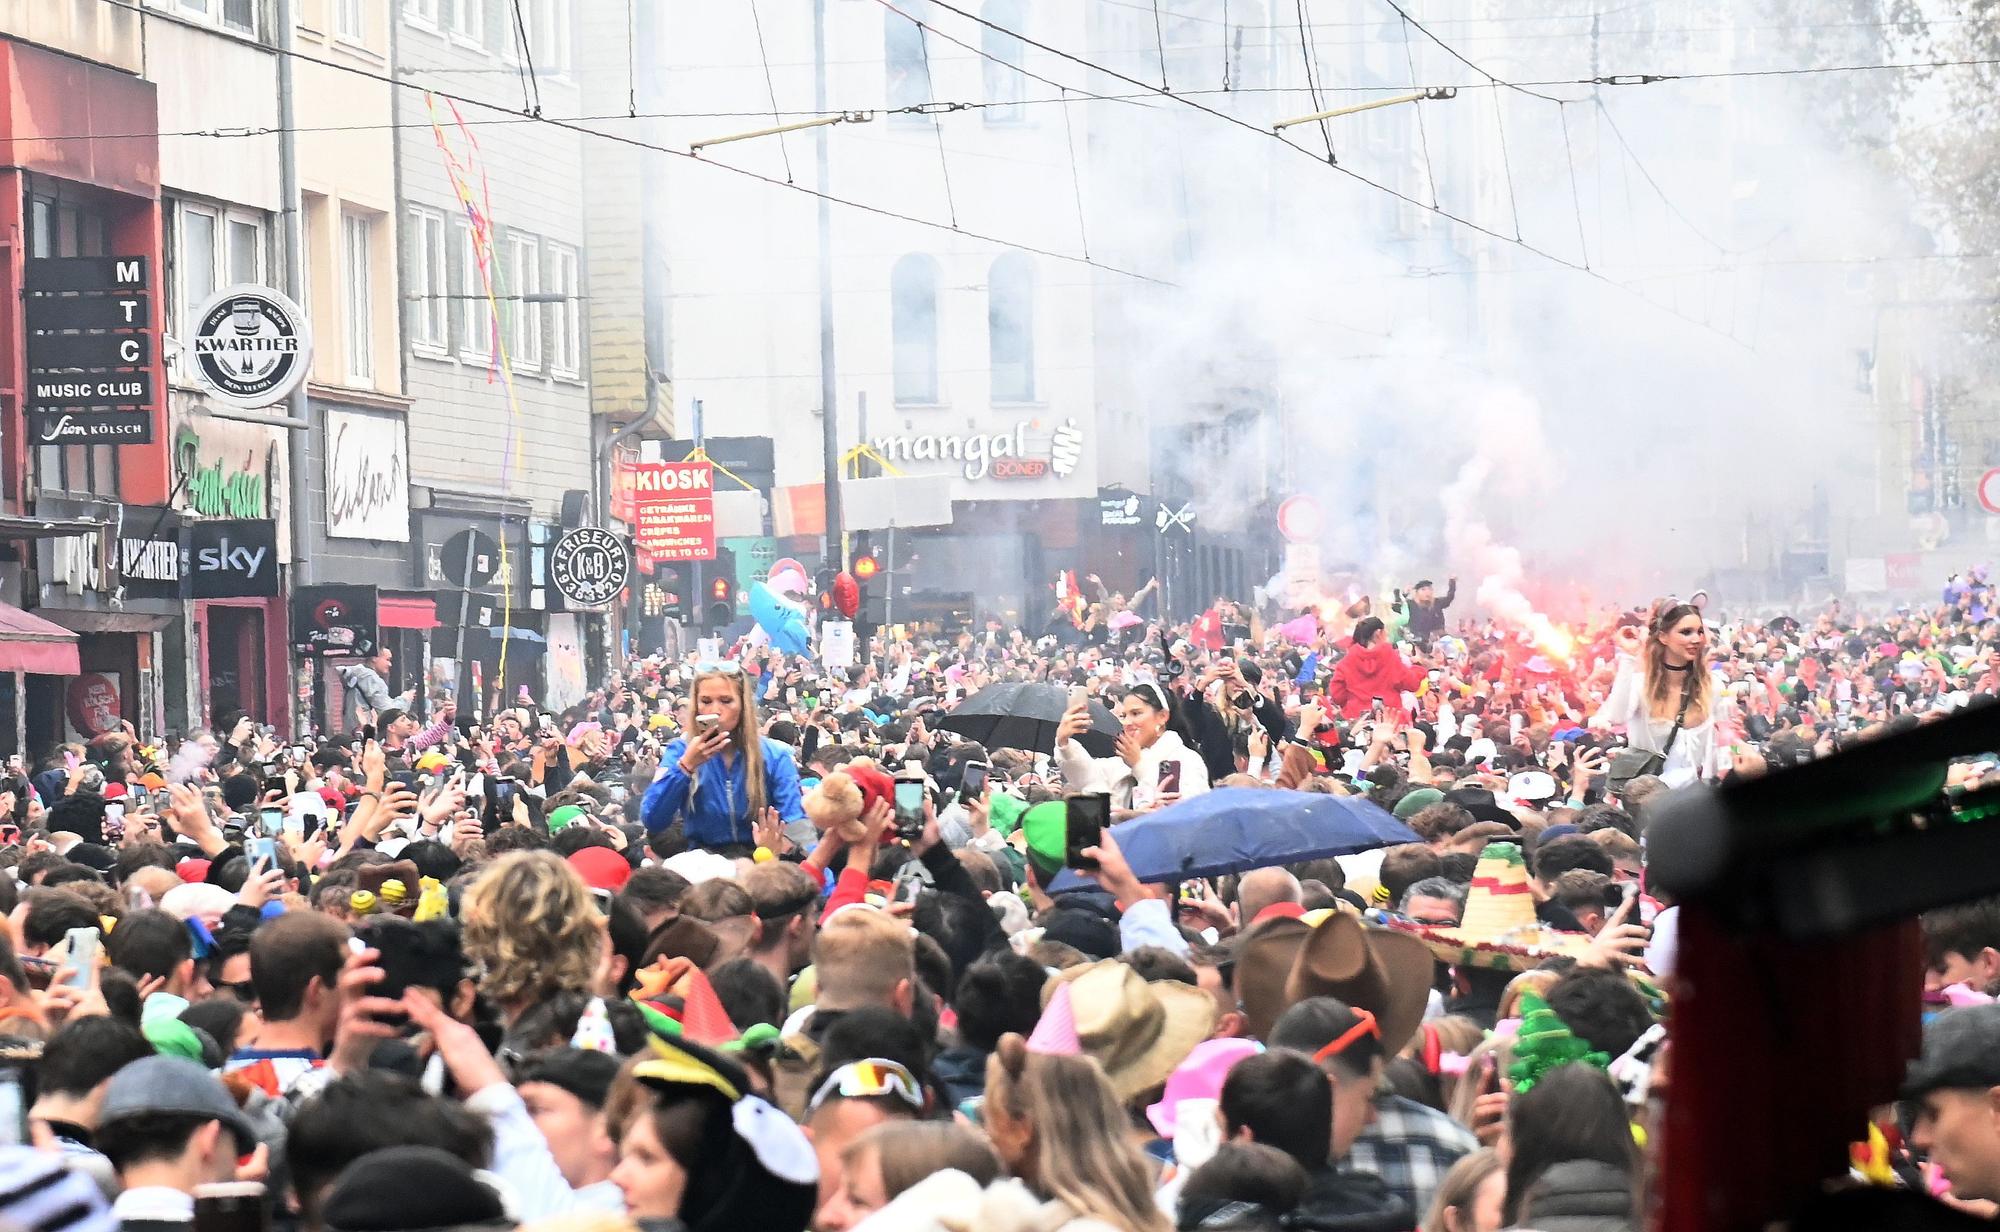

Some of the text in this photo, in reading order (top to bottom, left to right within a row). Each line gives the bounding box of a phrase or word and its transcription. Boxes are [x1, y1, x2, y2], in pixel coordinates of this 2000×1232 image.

[116, 261, 140, 283] M
[119, 300, 138, 323] T
[120, 340, 140, 362] C
[195, 338, 299, 352] KWARTIER
[37, 382, 143, 398] MUSIC CLUB
[90, 423, 142, 435] KÖLSCH
[873, 421, 1029, 480] mangal
[636, 468, 710, 491] KIOSK
[556, 530, 623, 560] FRISEUR
[679, 548, 692, 557] TO
[694, 547, 709, 556] GO
[121, 538, 178, 581] KWARTIER
[199, 537, 267, 579] sky
[576, 551, 604, 580] K&B
